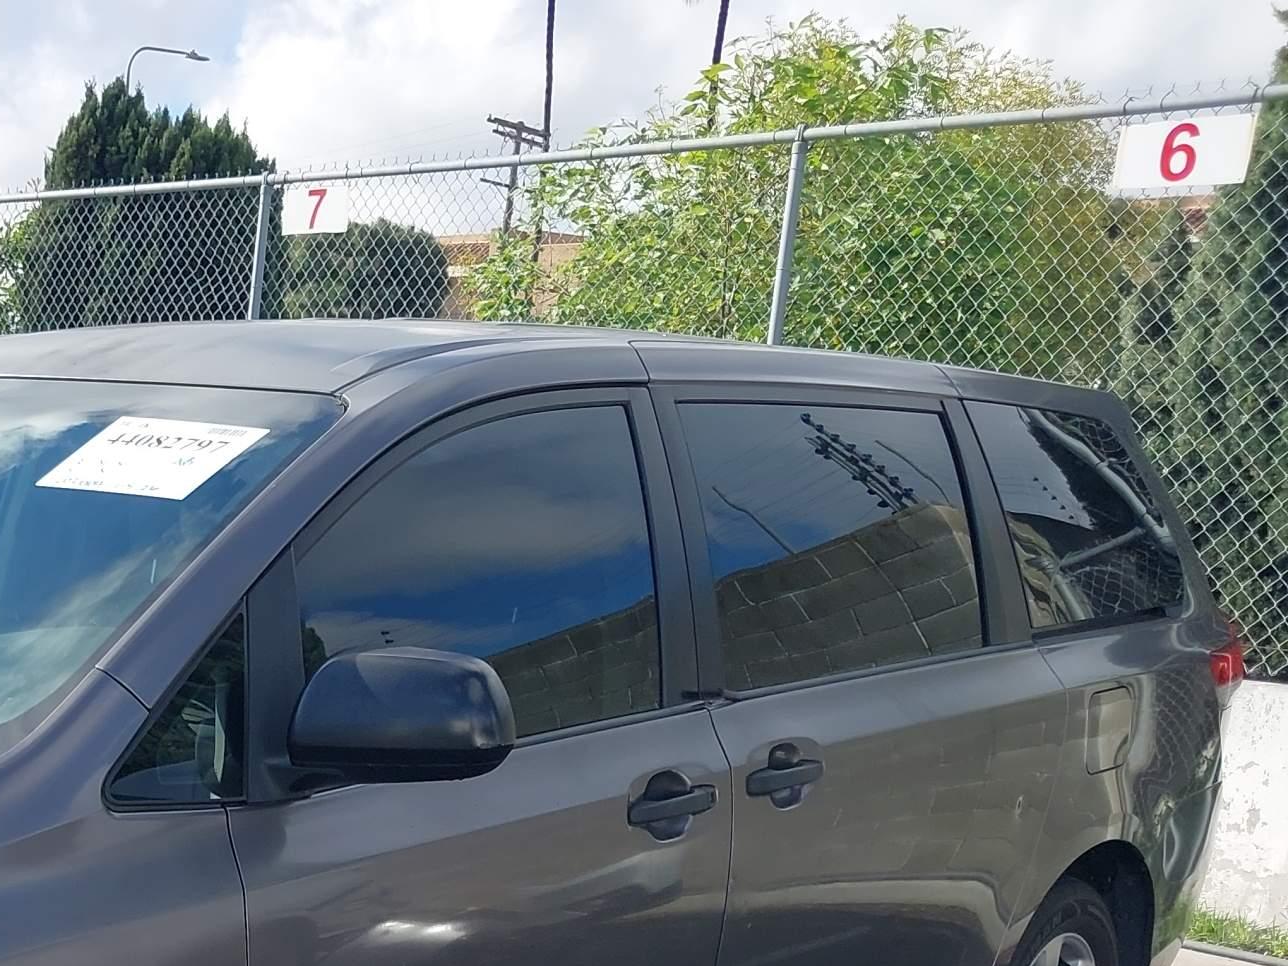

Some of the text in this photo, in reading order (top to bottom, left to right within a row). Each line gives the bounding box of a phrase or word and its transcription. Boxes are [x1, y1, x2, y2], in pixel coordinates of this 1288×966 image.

[1159, 122, 1201, 182] 6
[308, 188, 328, 230] 7
[106, 432, 232, 454] 44082797
